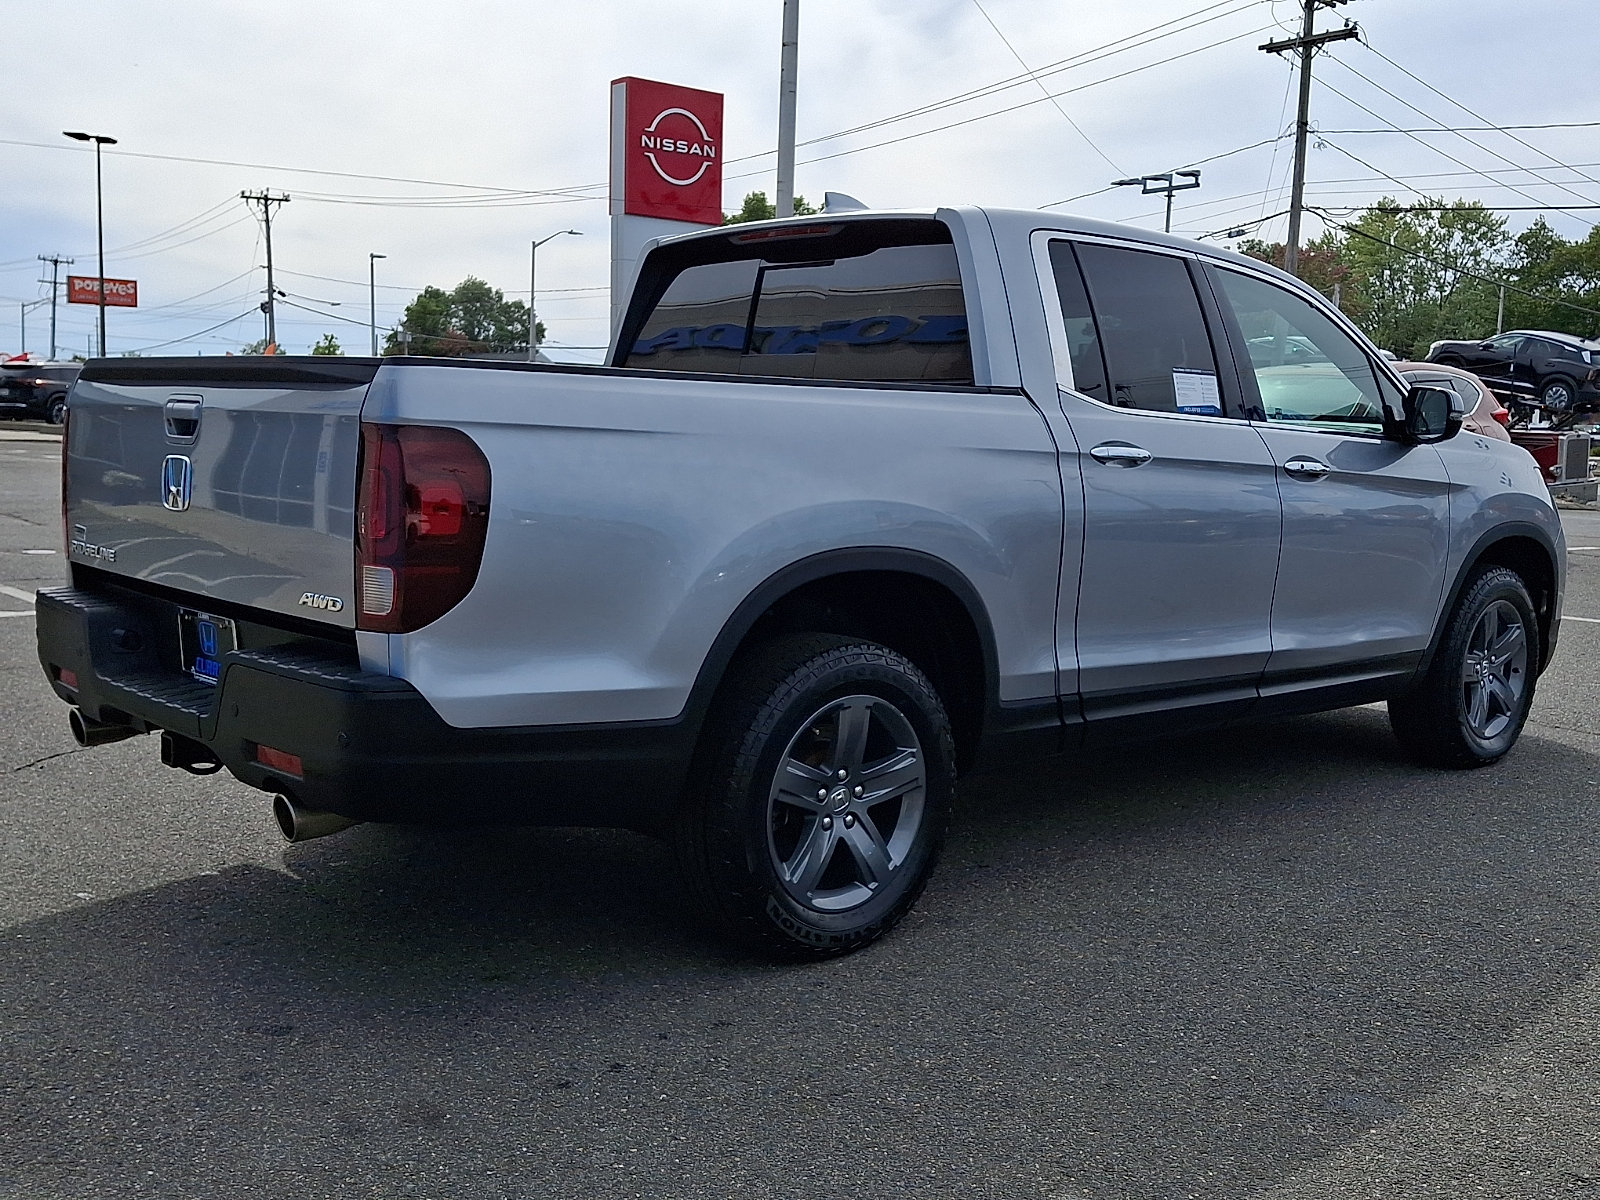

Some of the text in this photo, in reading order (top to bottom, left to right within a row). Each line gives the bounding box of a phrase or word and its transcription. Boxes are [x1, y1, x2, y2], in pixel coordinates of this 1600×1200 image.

[641, 134, 716, 158] NISSAN
[71, 539, 117, 562] RIDGELINE
[298, 592, 344, 612] AWD
